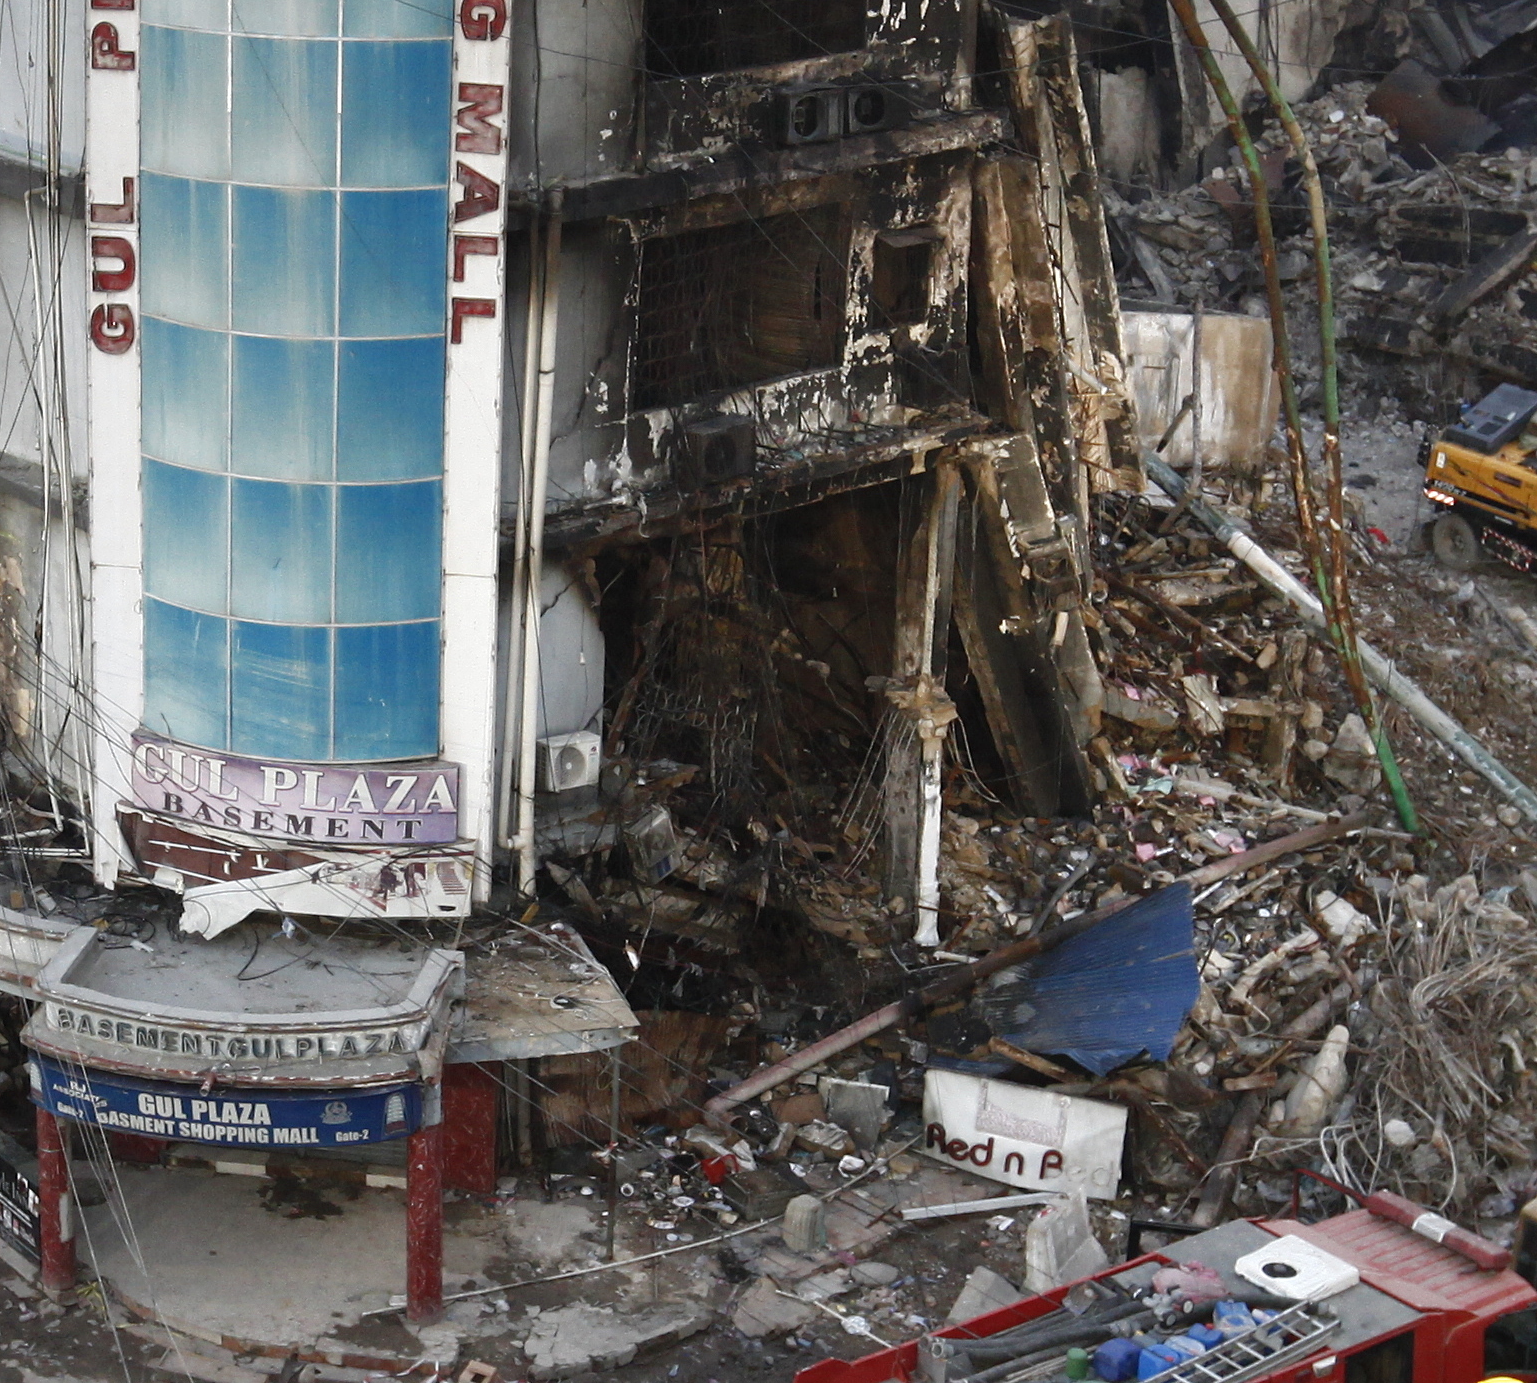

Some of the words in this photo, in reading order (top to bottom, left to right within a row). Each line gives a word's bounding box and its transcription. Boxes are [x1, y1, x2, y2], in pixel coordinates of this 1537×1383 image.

[451, 82, 504, 345] MALL
[90, 175, 137, 356] GUL
[133, 742, 240, 802] GUL
[258, 765, 457, 815] PLAZA
[161, 791, 423, 840] BASEMENT
[138, 1092, 187, 1120] GUL
[191, 1098, 272, 1126] PLAZA
[179, 1121, 269, 1144] SHOPPING
[273, 1127, 320, 1144] MALL
[335, 1128, 370, 1143] Gate-2
[926, 1121, 995, 1167] Red
[1003, 1151, 1025, 1176] n
